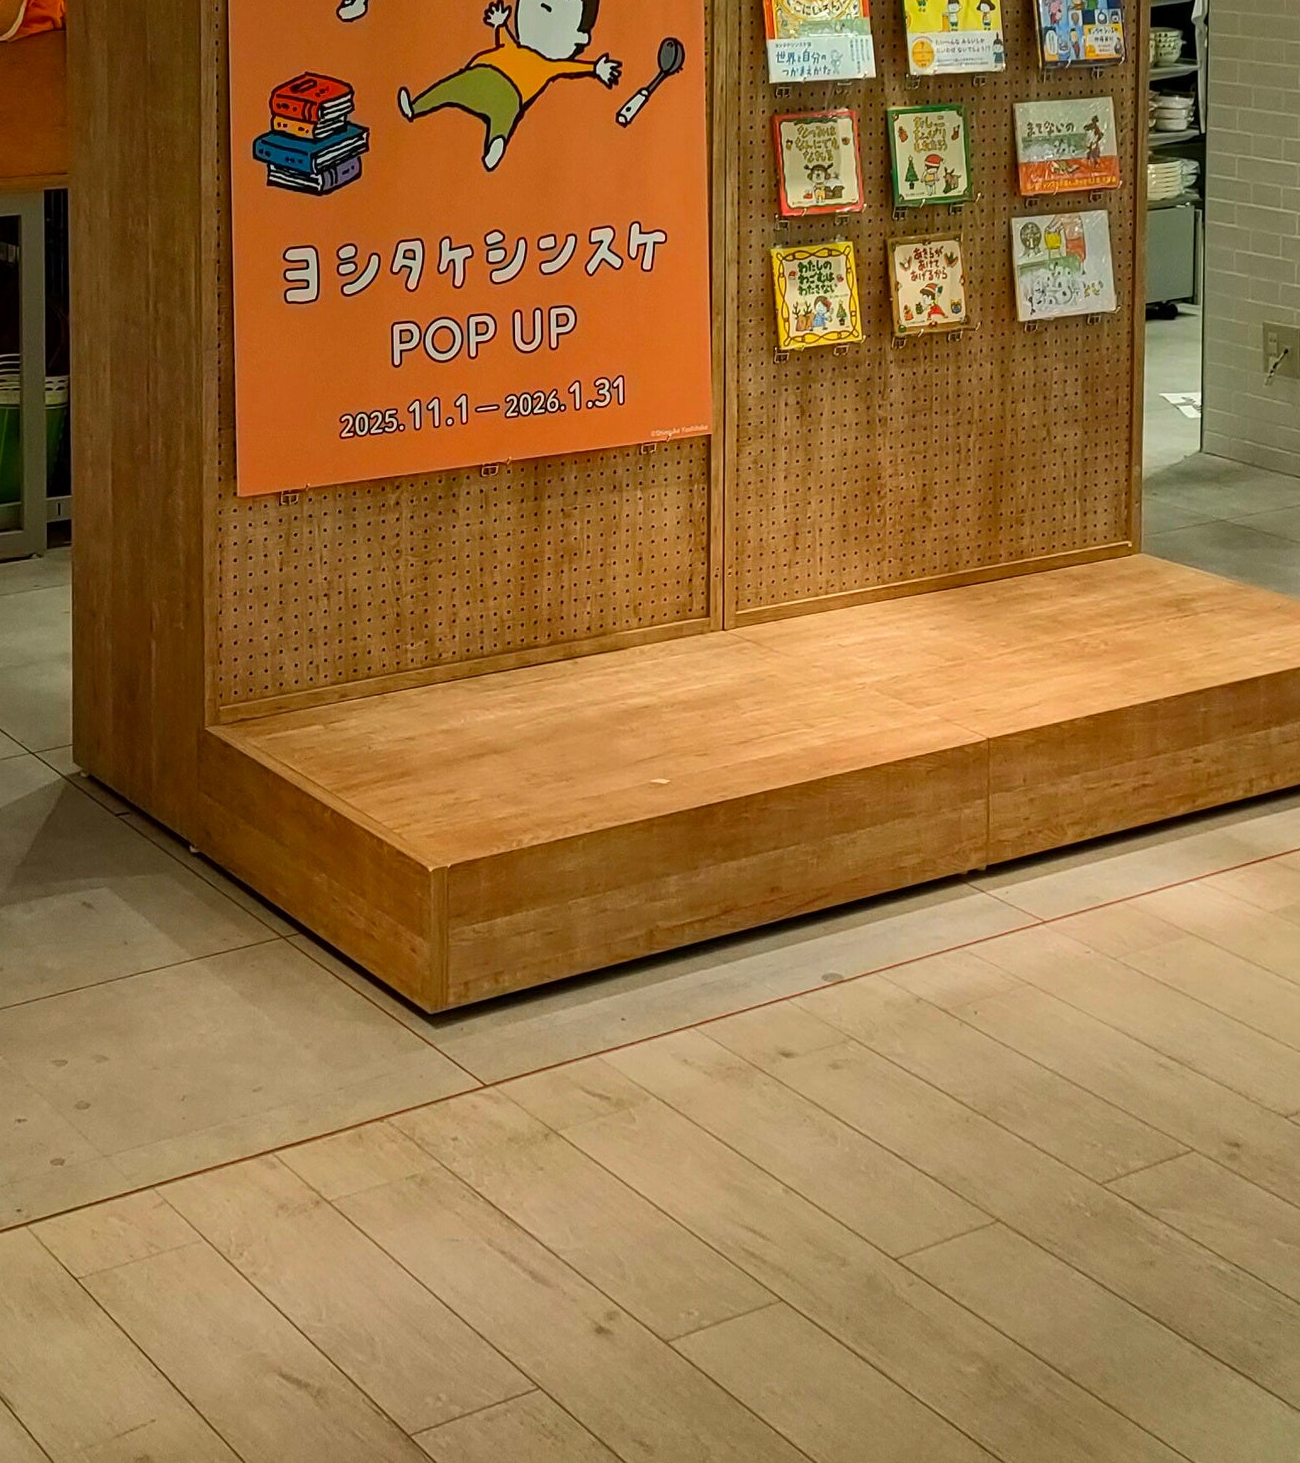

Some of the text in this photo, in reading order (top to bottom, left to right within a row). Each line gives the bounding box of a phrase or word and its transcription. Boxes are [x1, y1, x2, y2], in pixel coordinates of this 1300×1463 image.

[776, 50, 827, 66] 世界と自分の
[1027, 121, 1075, 138] まてないの
[913, 245, 944, 260] あきらが
[283, 222, 667, 304] ヨシタケシンスケ
[798, 260, 832, 274] わたしの
[918, 259, 940, 271] あけて
[798, 271, 835, 285] わごむは
[910, 267, 948, 282] あげるから
[798, 283, 838, 296] わたさない
[392, 306, 578, 367] POP UP
